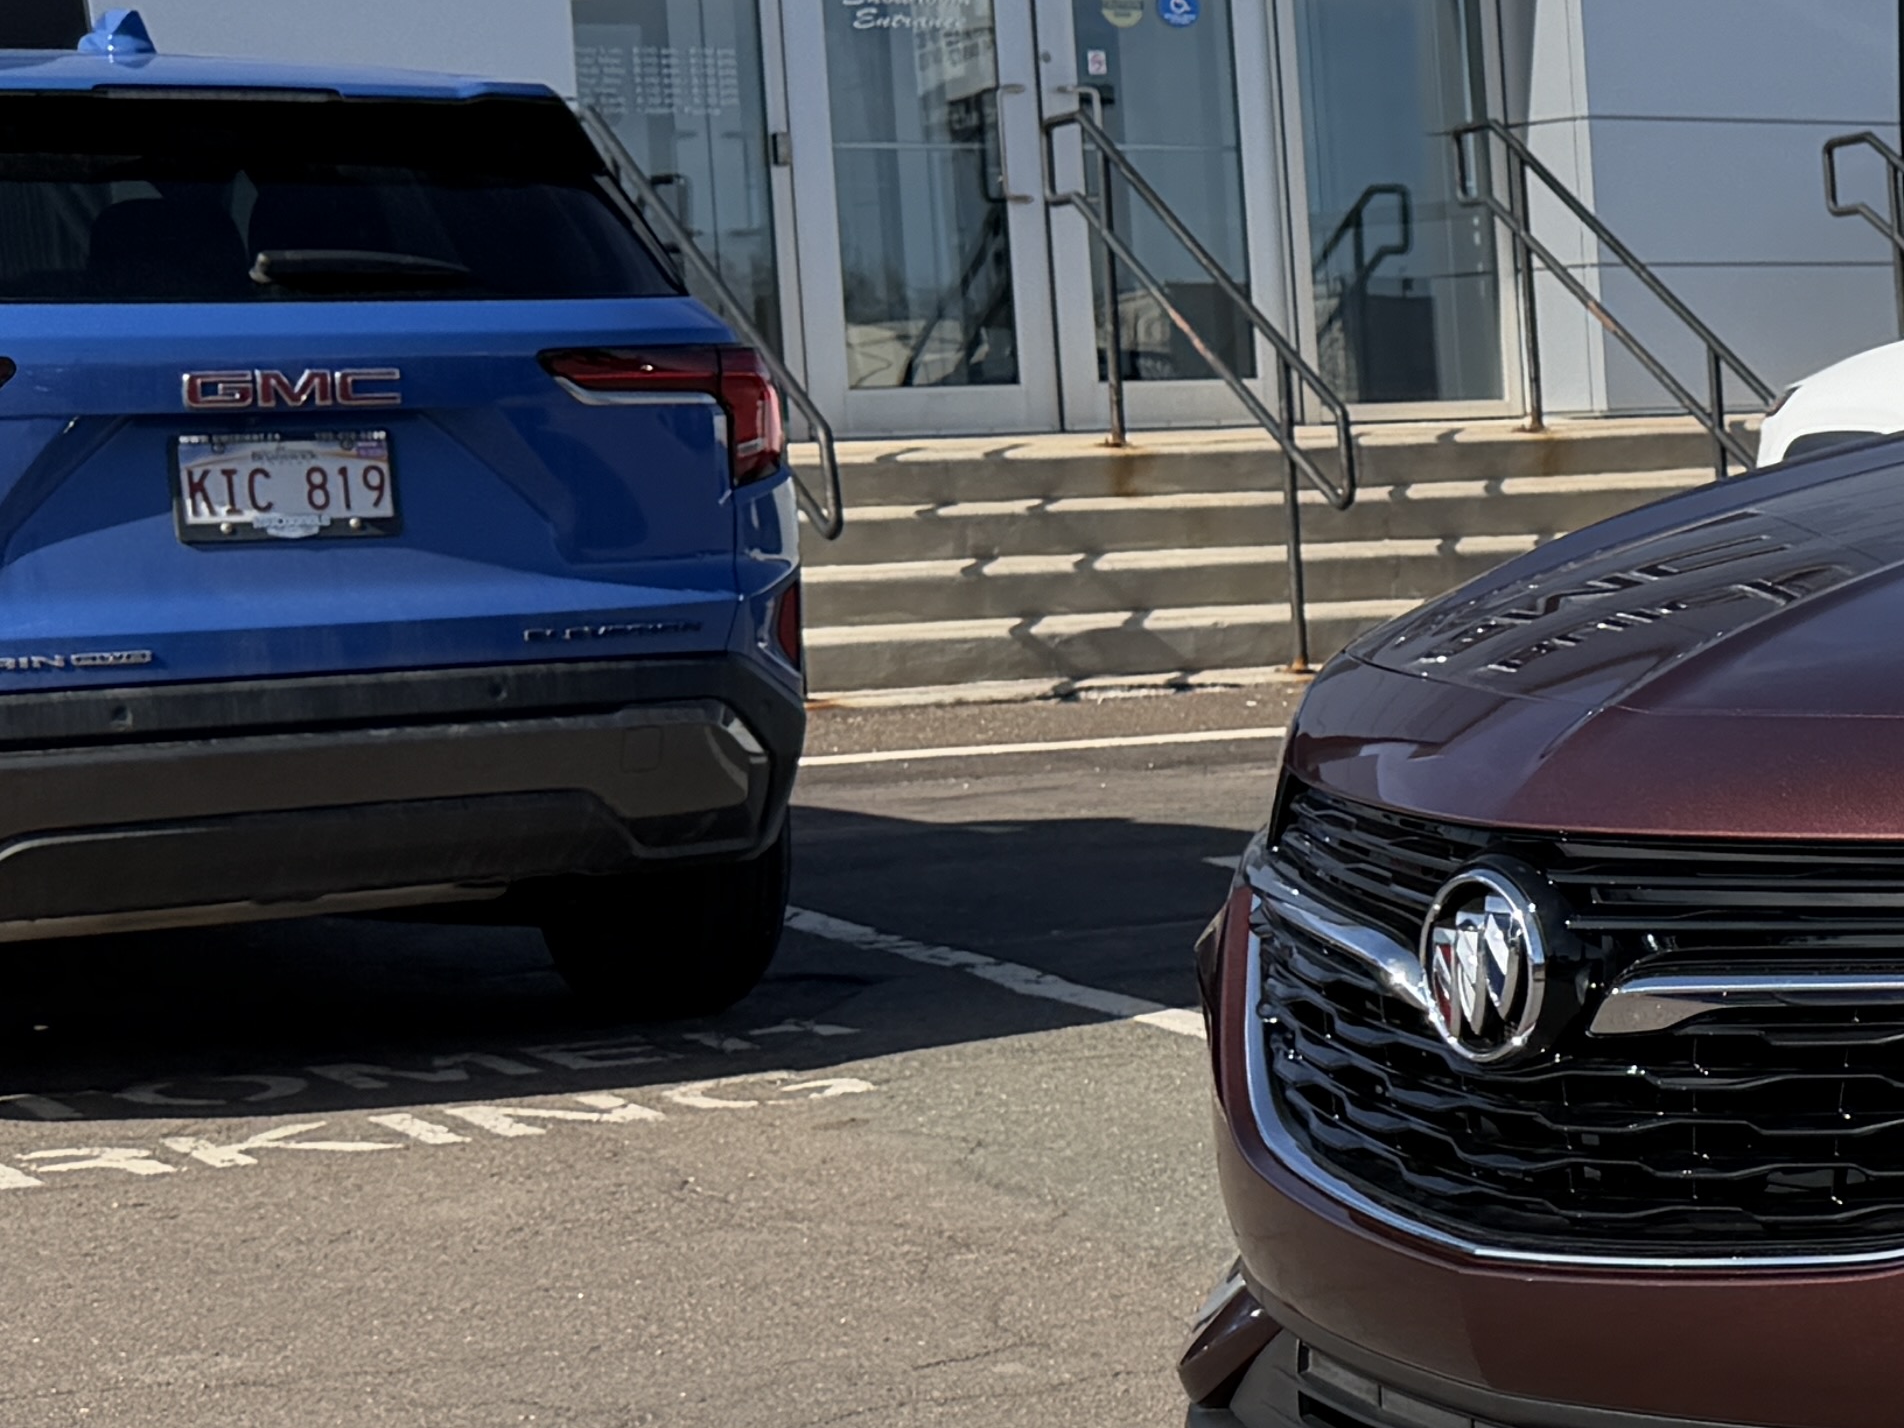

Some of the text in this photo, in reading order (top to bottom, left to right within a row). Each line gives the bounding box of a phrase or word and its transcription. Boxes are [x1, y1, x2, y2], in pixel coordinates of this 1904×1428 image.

[182, 368, 401, 408] GMC
[186, 465, 386, 517] KIC 819
